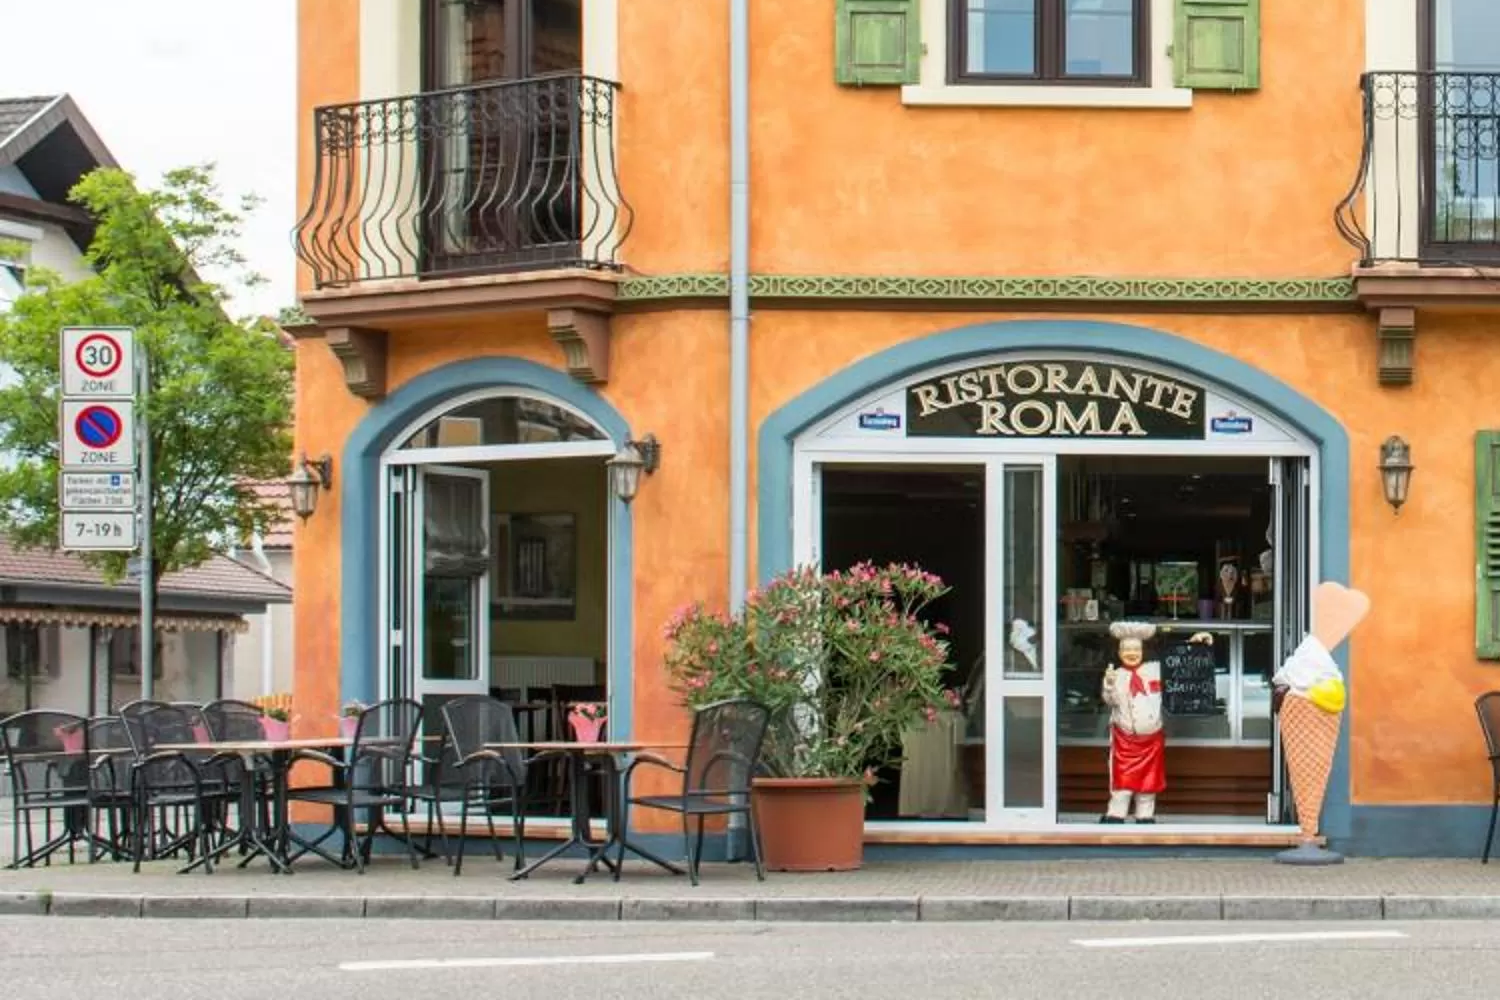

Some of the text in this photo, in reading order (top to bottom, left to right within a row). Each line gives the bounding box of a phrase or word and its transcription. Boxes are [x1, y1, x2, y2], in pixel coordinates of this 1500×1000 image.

[85, 345, 112, 366] 30
[81, 380, 116, 392] ZONE
[911, 363, 1198, 419] RISTORANTE
[976, 399, 1148, 436] ROMA
[80, 451, 117, 463] ZONE
